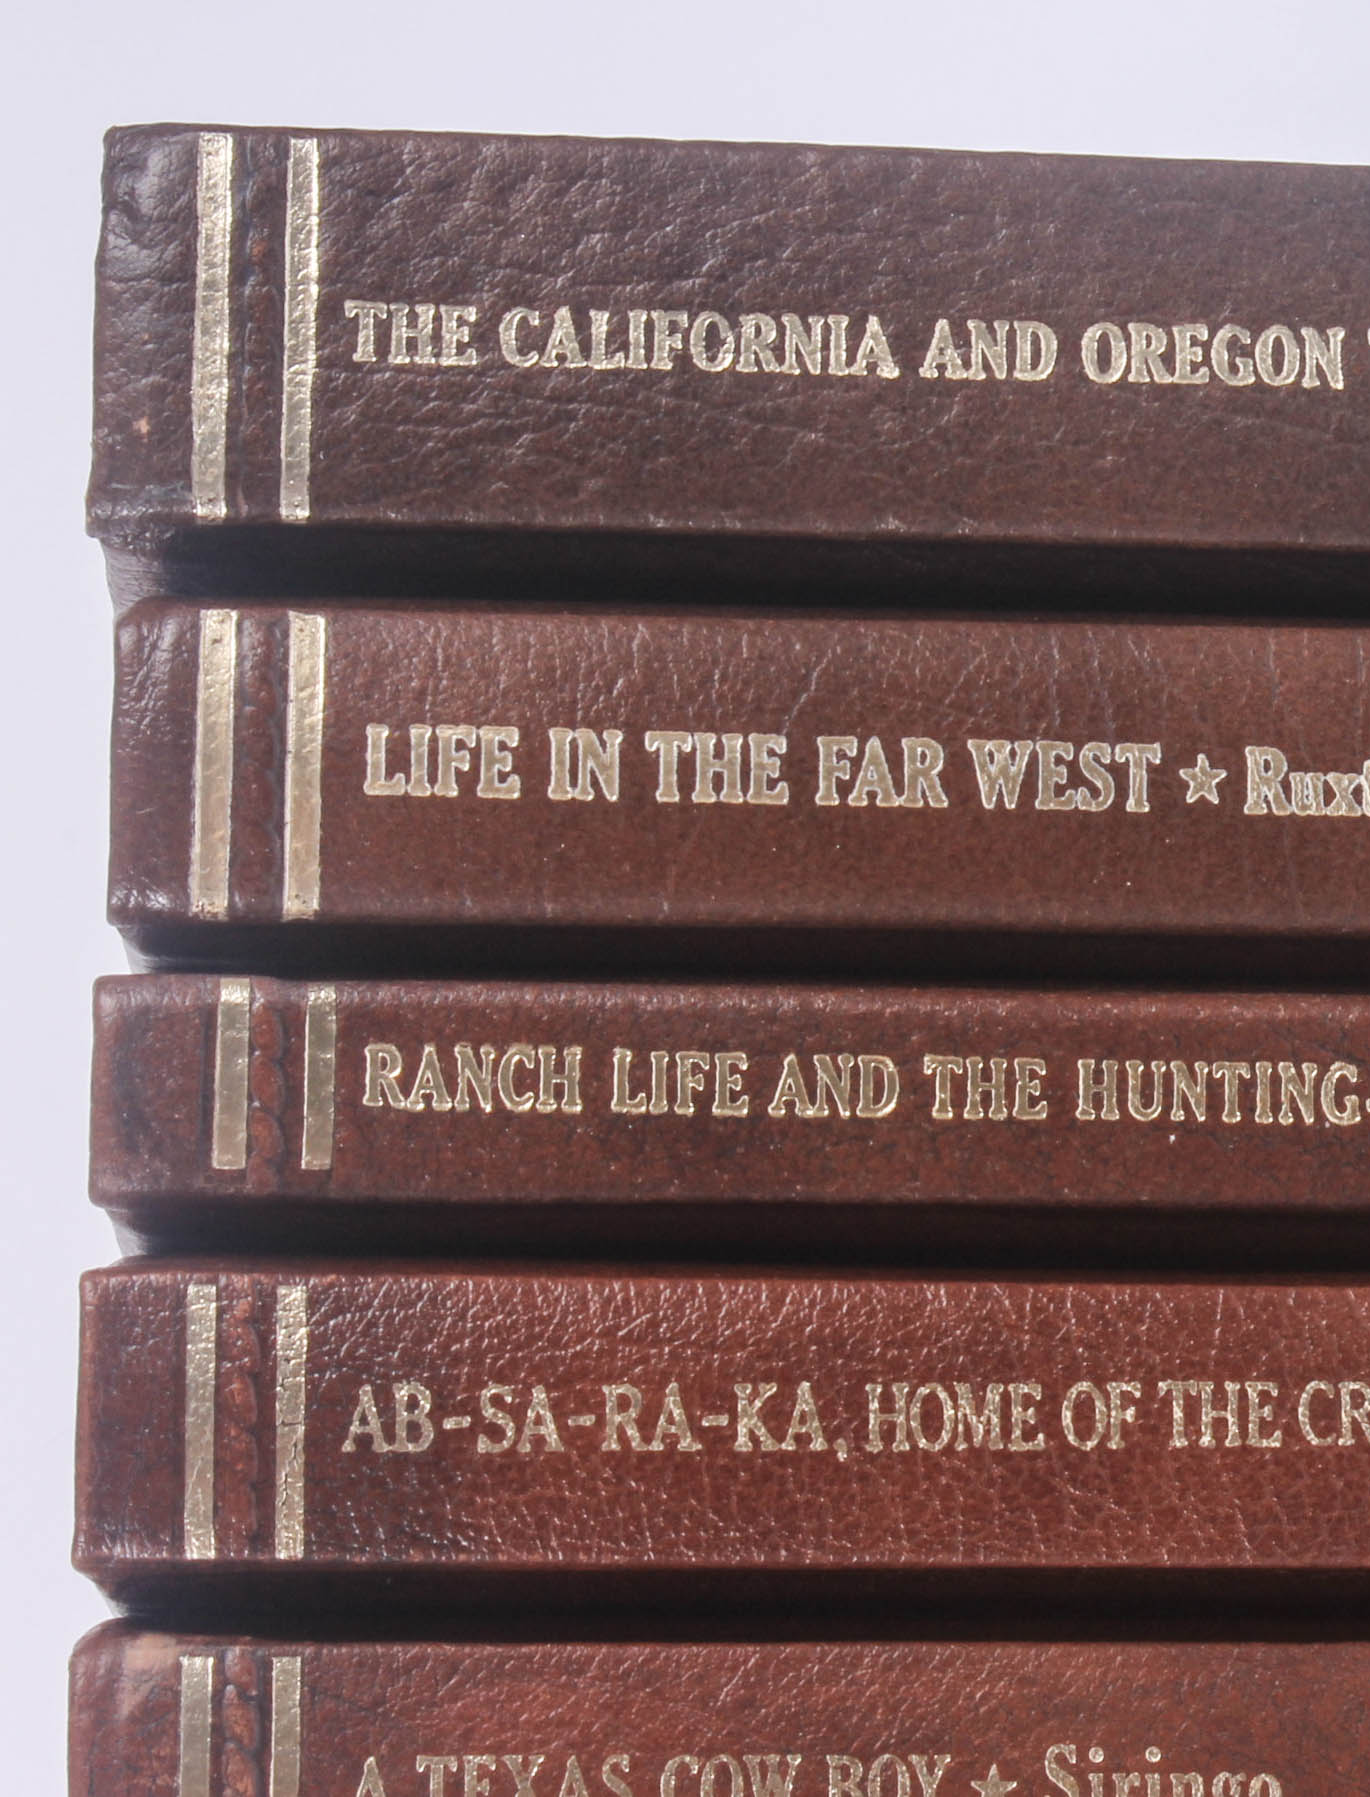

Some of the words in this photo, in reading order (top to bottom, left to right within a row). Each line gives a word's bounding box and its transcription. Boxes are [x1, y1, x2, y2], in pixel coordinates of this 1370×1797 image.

[344, 300, 476, 366] THE
[500, 306, 899, 379] CALIFORNIA
[918, 319, 1057, 384] AND
[1081, 322, 1346, 388] OREGON
[363, 723, 520, 798] LIFE
[548, 728, 622, 801] IN
[646, 730, 789, 804] THE
[815, 736, 948, 808] FAR
[968, 739, 1161, 813] WEST
[363, 1043, 582, 1113] RANCH
[609, 1047, 749, 1116] LIFE
[769, 1053, 899, 1118] AND
[924, 1054, 1047, 1120] THE
[342, 1381, 848, 1463] AB-SA-RA-KA,
[865, 1382, 1044, 1452] HOME
[1062, 1381, 1141, 1451] OF
[1158, 1380, 1282, 1449] THE
[356, 1756, 386, 1797] A
[416, 1755, 633, 1797] TEXAS
[660, 1754, 801, 1797] COW
[827, 1754, 951, 1797] BOY
